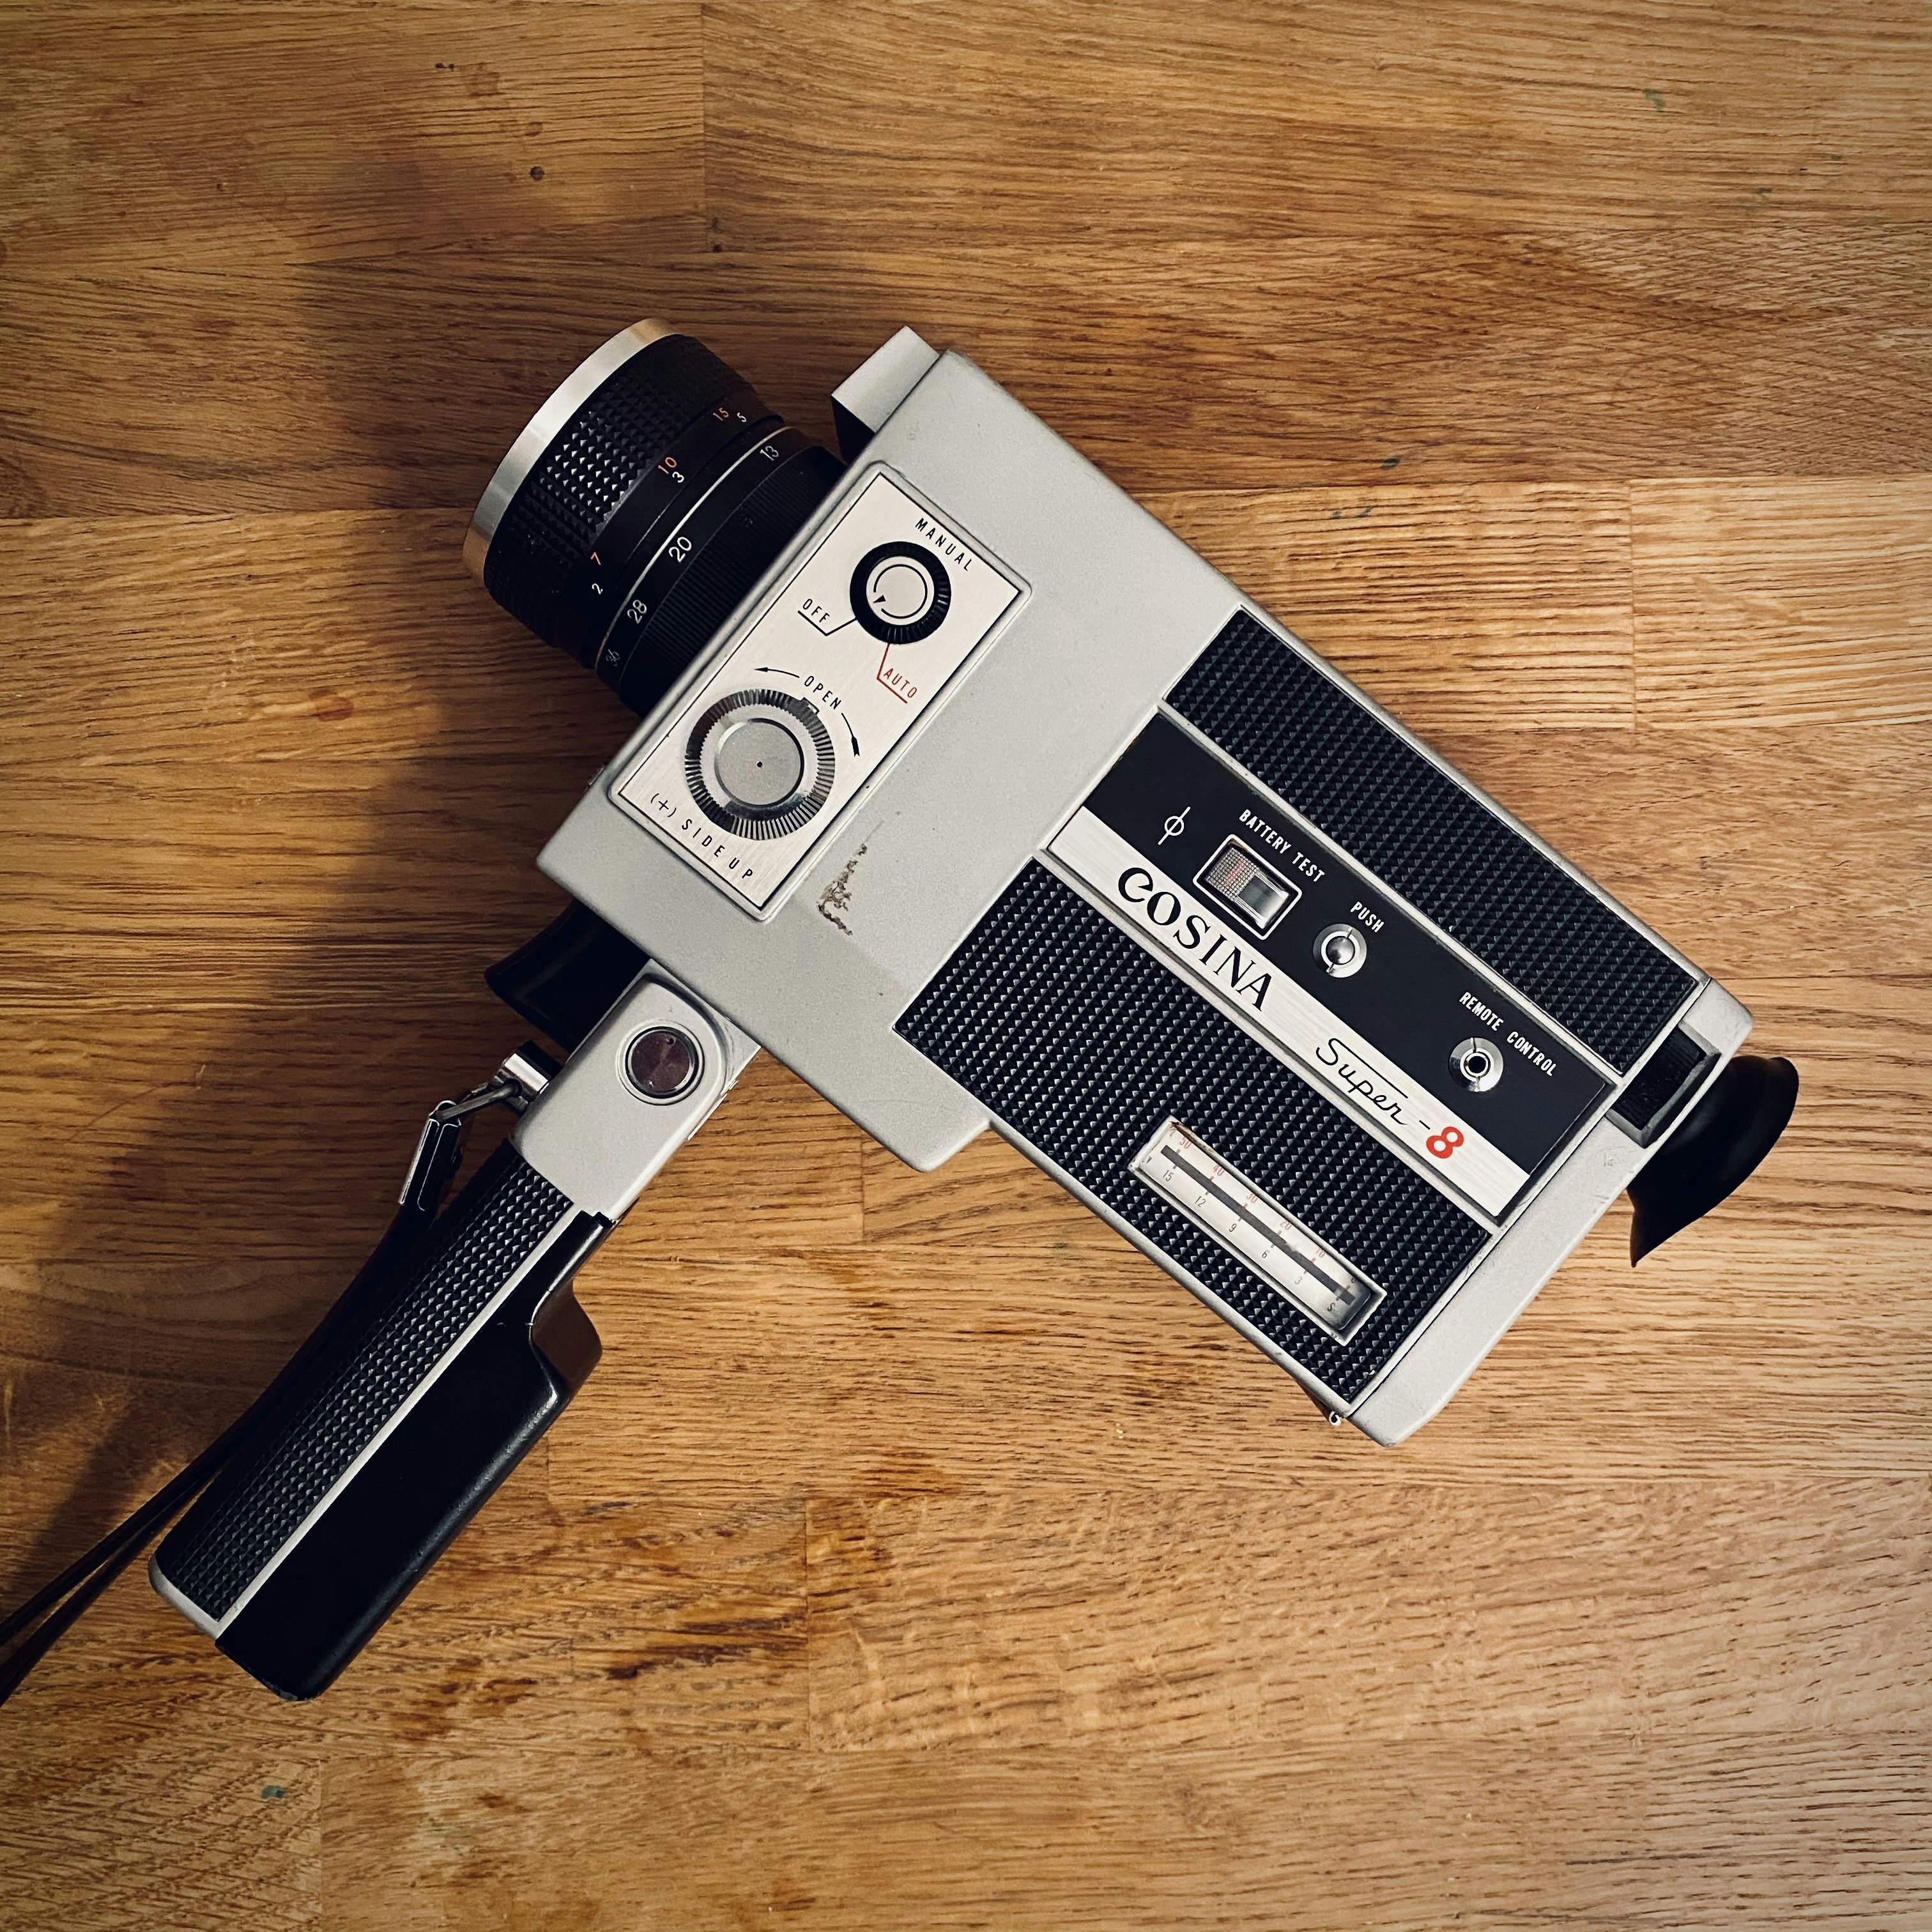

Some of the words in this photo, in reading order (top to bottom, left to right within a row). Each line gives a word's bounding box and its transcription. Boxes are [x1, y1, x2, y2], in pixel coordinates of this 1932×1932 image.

[590, 551, 601, 565] 7
[658, 457, 677, 474] 10
[712, 407, 729, 422] 15
[592, 583, 603, 595] 2
[672, 471, 684, 483] 3
[737, 412, 747, 423] 5
[606, 648, 621, 666] 36
[627, 599, 647, 624] 28
[668, 536, 692, 563] 20
[760, 445, 779, 461] 13
[915, 518, 972, 571] MANUAL
[802, 598, 831, 623] OFF
[804, 675, 843, 710] OPEN
[883, 668, 917, 698] AUTO
[1239, 809, 1292, 854] BATTERY
[1291, 852, 1325, 882] TEST
[1117, 867, 1272, 1012] COSINA
[1350, 901, 1384, 933] PUSH
[1459, 992, 1504, 1031] REMOTE
[1506, 1031, 1556, 1077] CONTROL
[1163, 1170, 1174, 1182] 15
[1195, 1195, 1206, 1208] 12
[1229, 1223, 1237, 1233] 9
[1261, 1250, 1270, 1259] 6
[1294, 1276, 1303, 1285] 3
